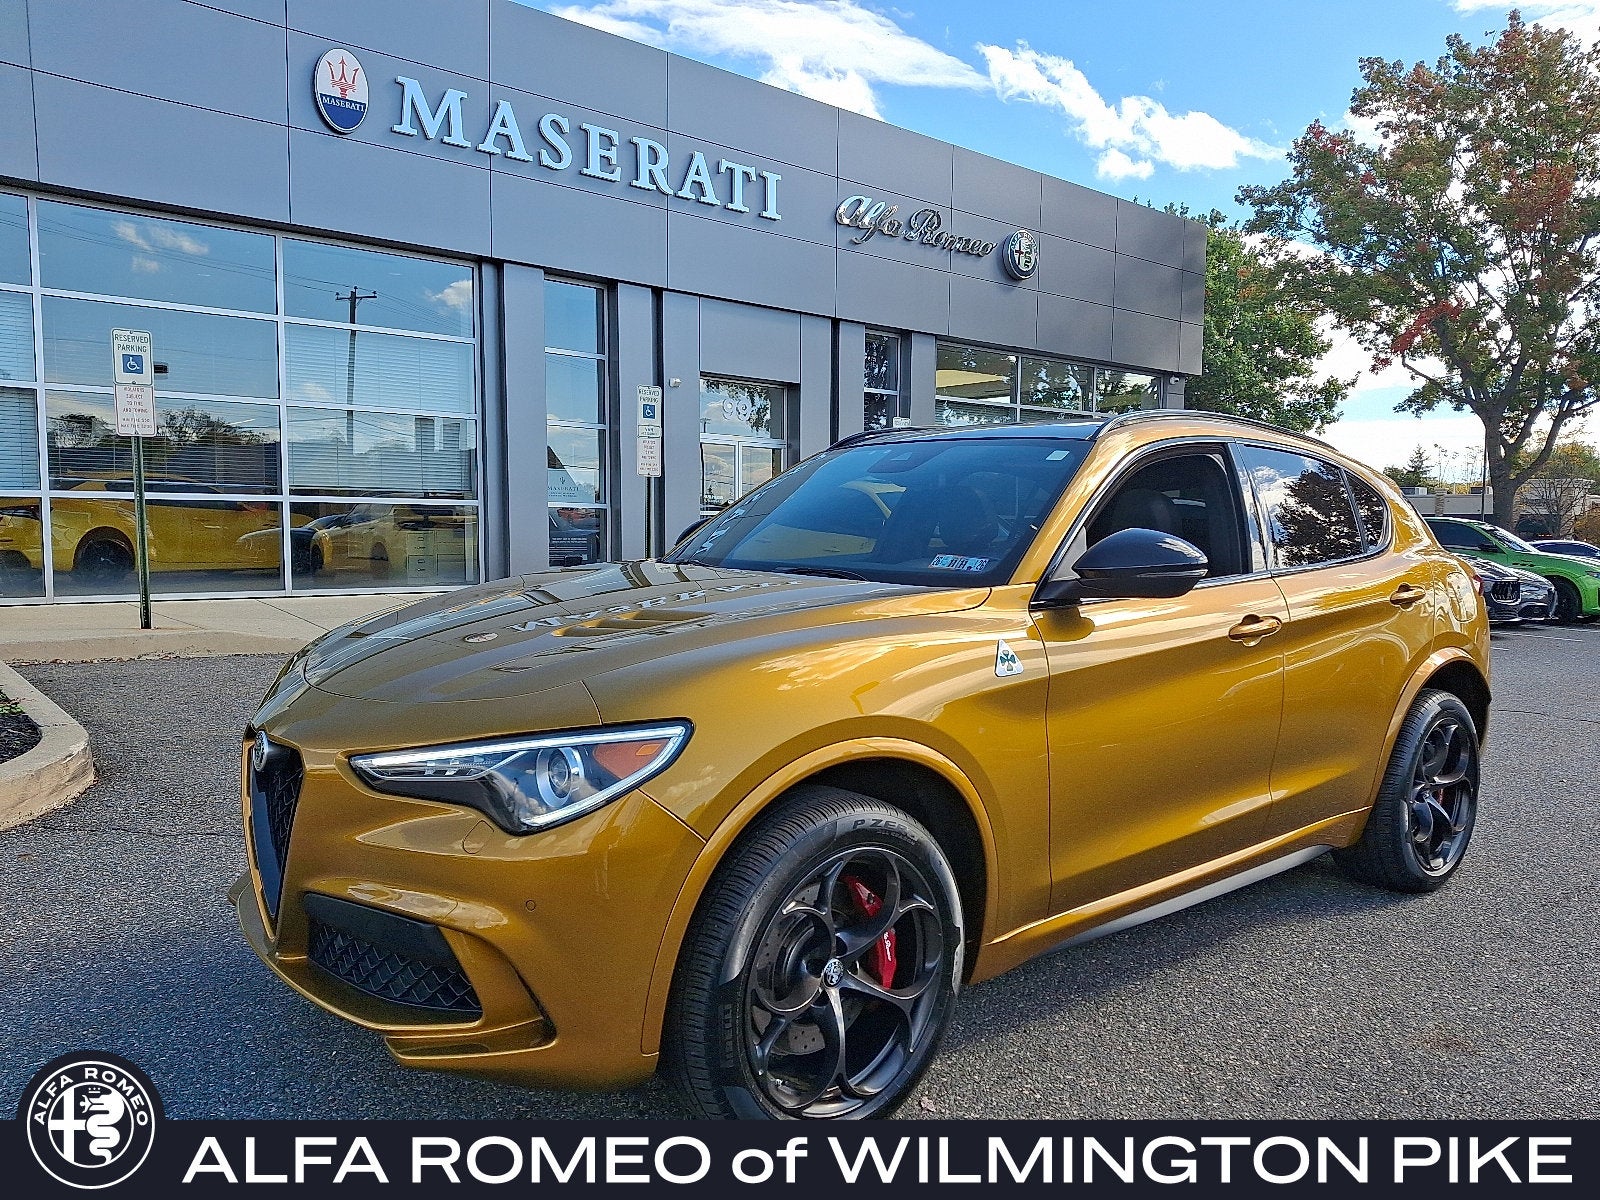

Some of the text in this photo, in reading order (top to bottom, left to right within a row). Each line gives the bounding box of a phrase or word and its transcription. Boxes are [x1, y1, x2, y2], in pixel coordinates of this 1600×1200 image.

[322, 96, 365, 112] MASERATI
[392, 75, 782, 221] MASERATI
[836, 195, 998, 257] Alfa Romeo
[114, 334, 149, 343] RESERVED
[117, 344, 147, 352] PARKING
[852, 819, 866, 830] P
